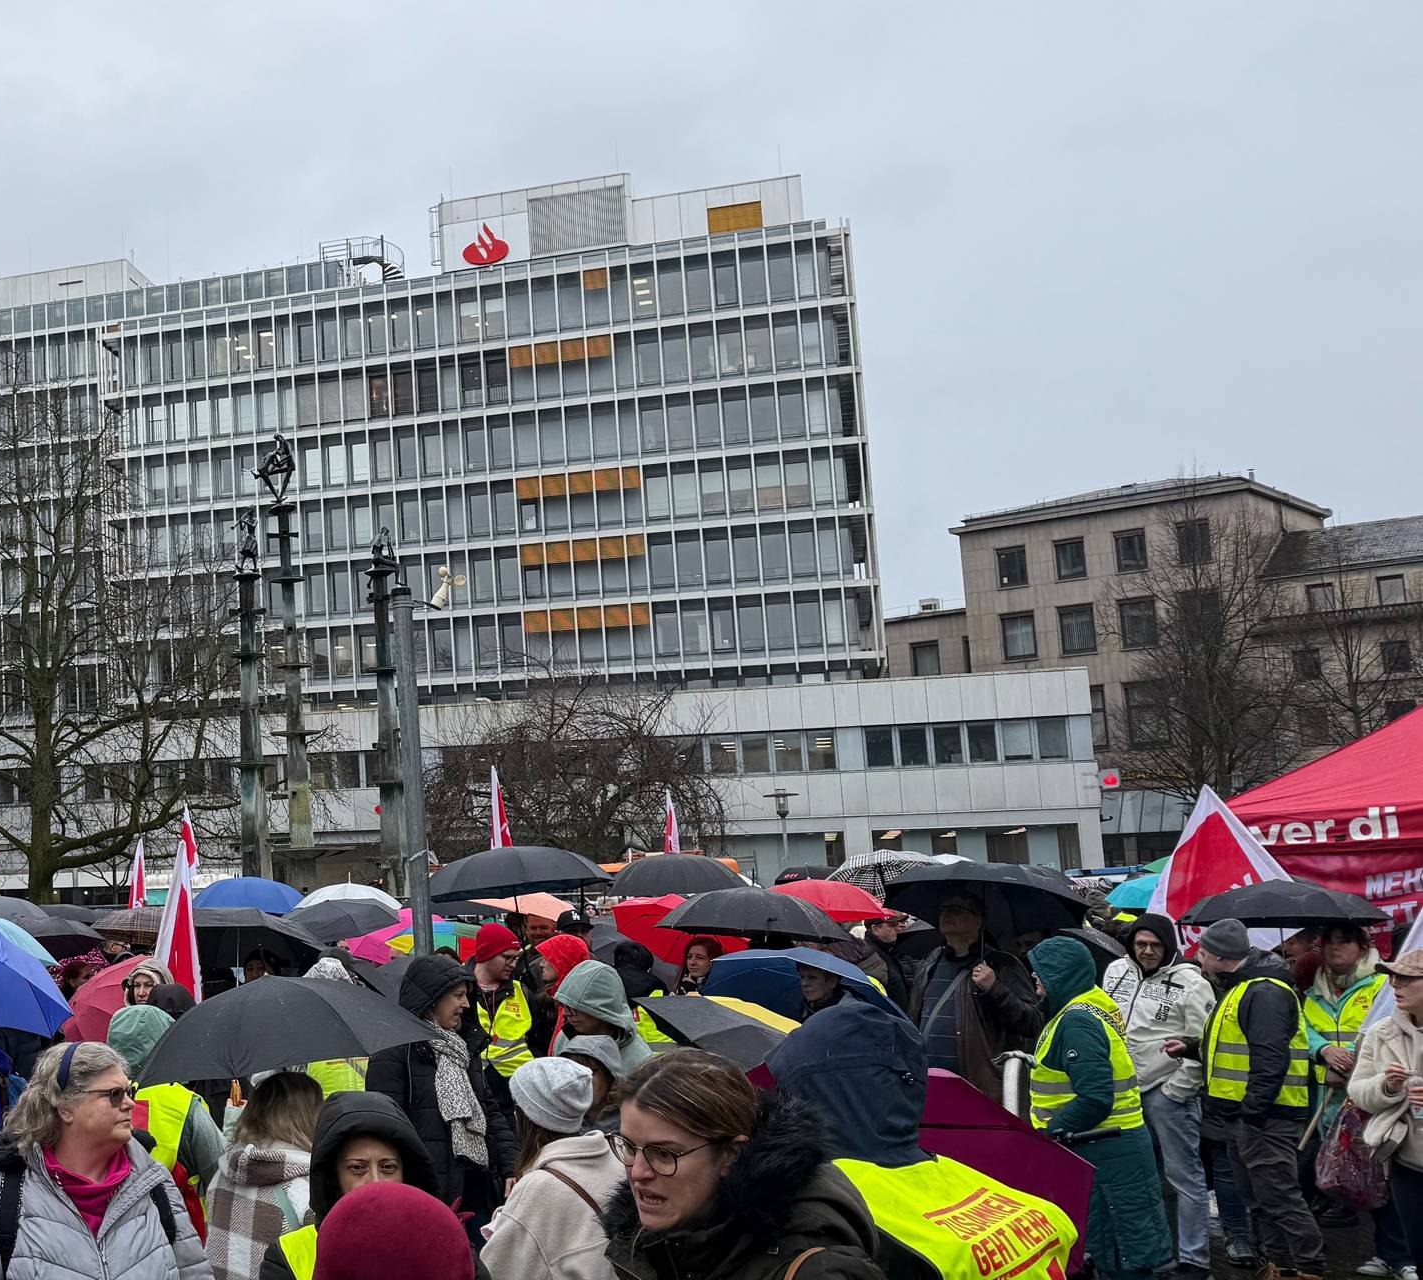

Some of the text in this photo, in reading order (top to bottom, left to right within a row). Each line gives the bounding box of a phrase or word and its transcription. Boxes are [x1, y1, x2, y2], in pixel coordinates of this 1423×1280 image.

[1365, 868, 1423, 900] MEH
[934, 1192, 1026, 1241] ZUSAMMEN
[971, 1208, 1058, 1277] GEHT MEHR
